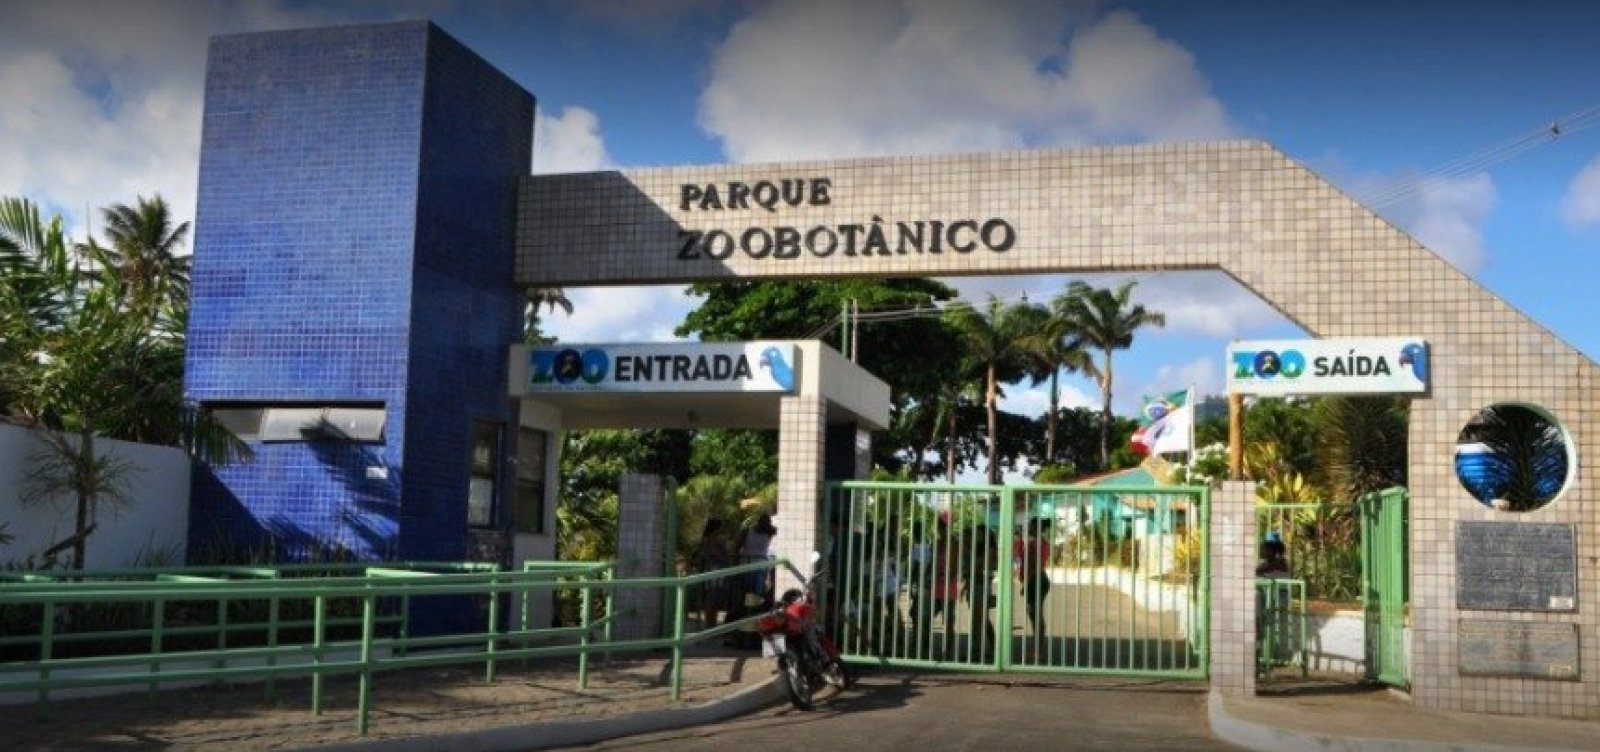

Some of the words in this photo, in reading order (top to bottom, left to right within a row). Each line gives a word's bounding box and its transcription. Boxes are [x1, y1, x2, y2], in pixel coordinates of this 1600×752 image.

[680, 178, 832, 211] PARQUE
[678, 215, 1016, 260] ZOOBOTÂNICO
[531, 348, 609, 385] ZOO
[614, 354, 753, 382] ENTRADA
[1233, 349, 1306, 379] ZOO
[1313, 349, 1391, 377] SAÍDA
